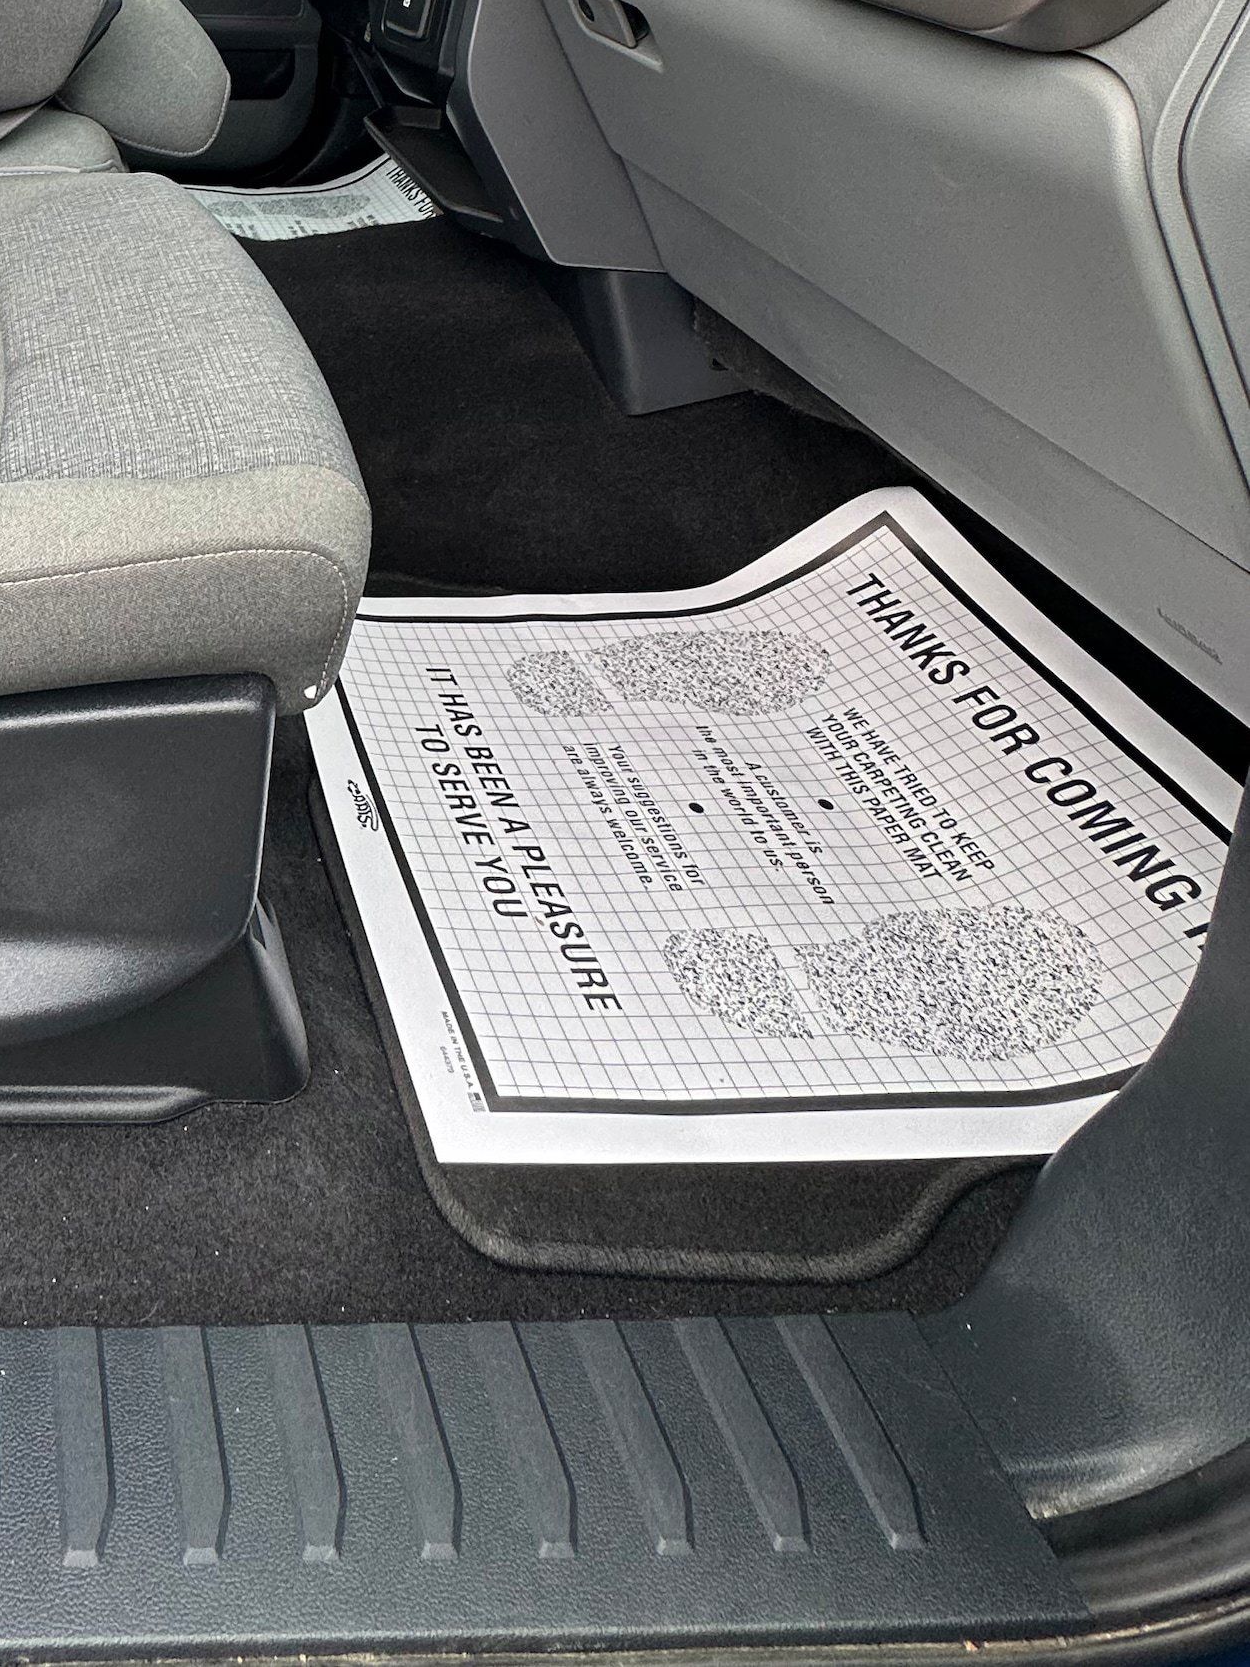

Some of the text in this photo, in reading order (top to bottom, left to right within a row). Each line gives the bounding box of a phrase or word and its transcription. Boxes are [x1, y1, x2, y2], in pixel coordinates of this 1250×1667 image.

[562, 745, 654, 891] are always welcome.
[583, 742, 684, 893] improving our service
[608, 744, 706, 886] Your suggestions for
[692, 749, 784, 872] in the world to us.
[696, 725, 836, 906] the most important person
[745, 761, 823, 854] A customer is
[806, 726, 943, 881] WITH THIS PAPER MAT
[822, 713, 973, 883] YOUR CARPETING CLEAN
[843, 707, 996, 871] WE HAVE TRIED TO KEEP
[846, 572, 971, 685] THANKS
[951, 685, 1041, 756] FOR
[1024, 757, 1203, 913] COMING
[415, 724, 529, 919] TO SERVE YOU
[425, 667, 624, 1012] IT HAS BEEN A PLEASURE
[441, 1011, 455, 1034] MADE
[454, 1047, 466, 1063] THE
